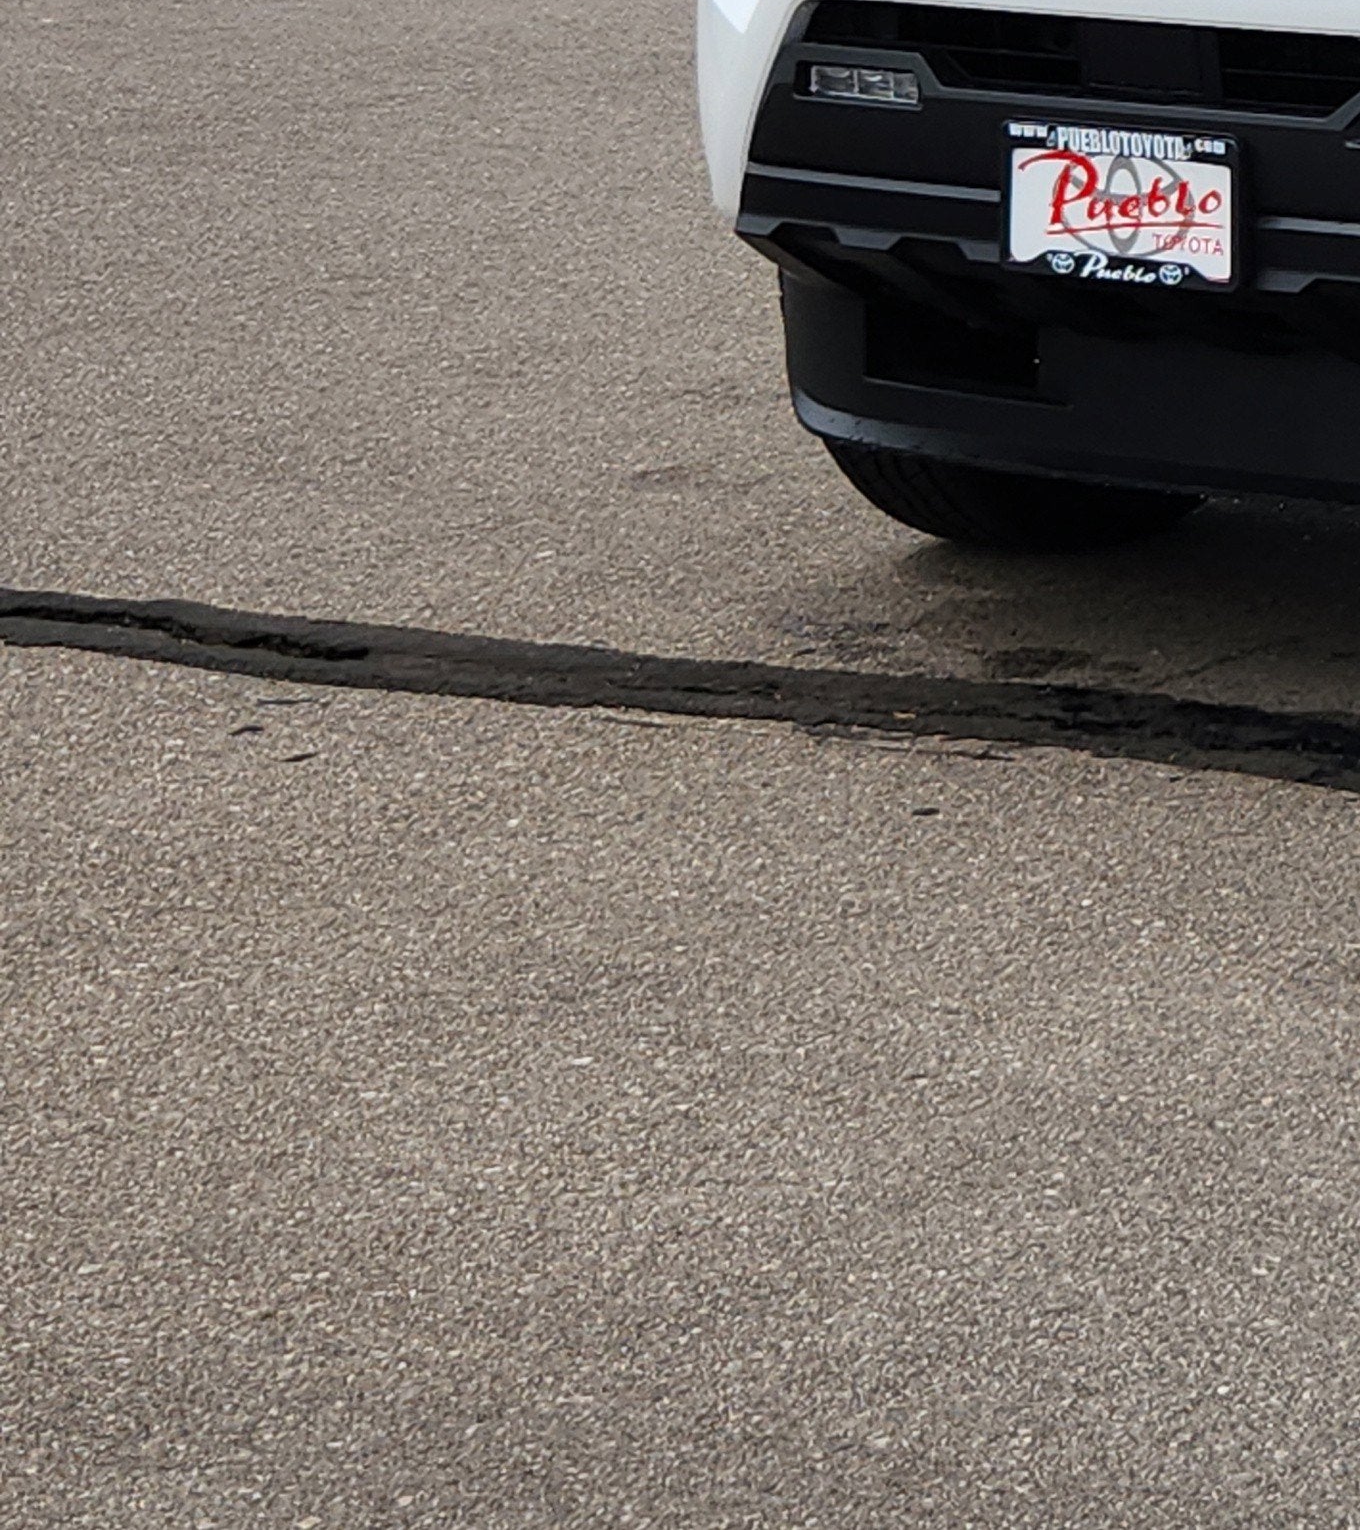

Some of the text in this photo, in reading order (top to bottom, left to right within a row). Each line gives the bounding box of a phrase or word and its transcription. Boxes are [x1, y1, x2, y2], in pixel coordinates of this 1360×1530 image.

[1018, 151, 1222, 226] Pueblo
[1152, 233, 1224, 257] TOYOTA
[1074, 251, 1157, 284] Pueblo
